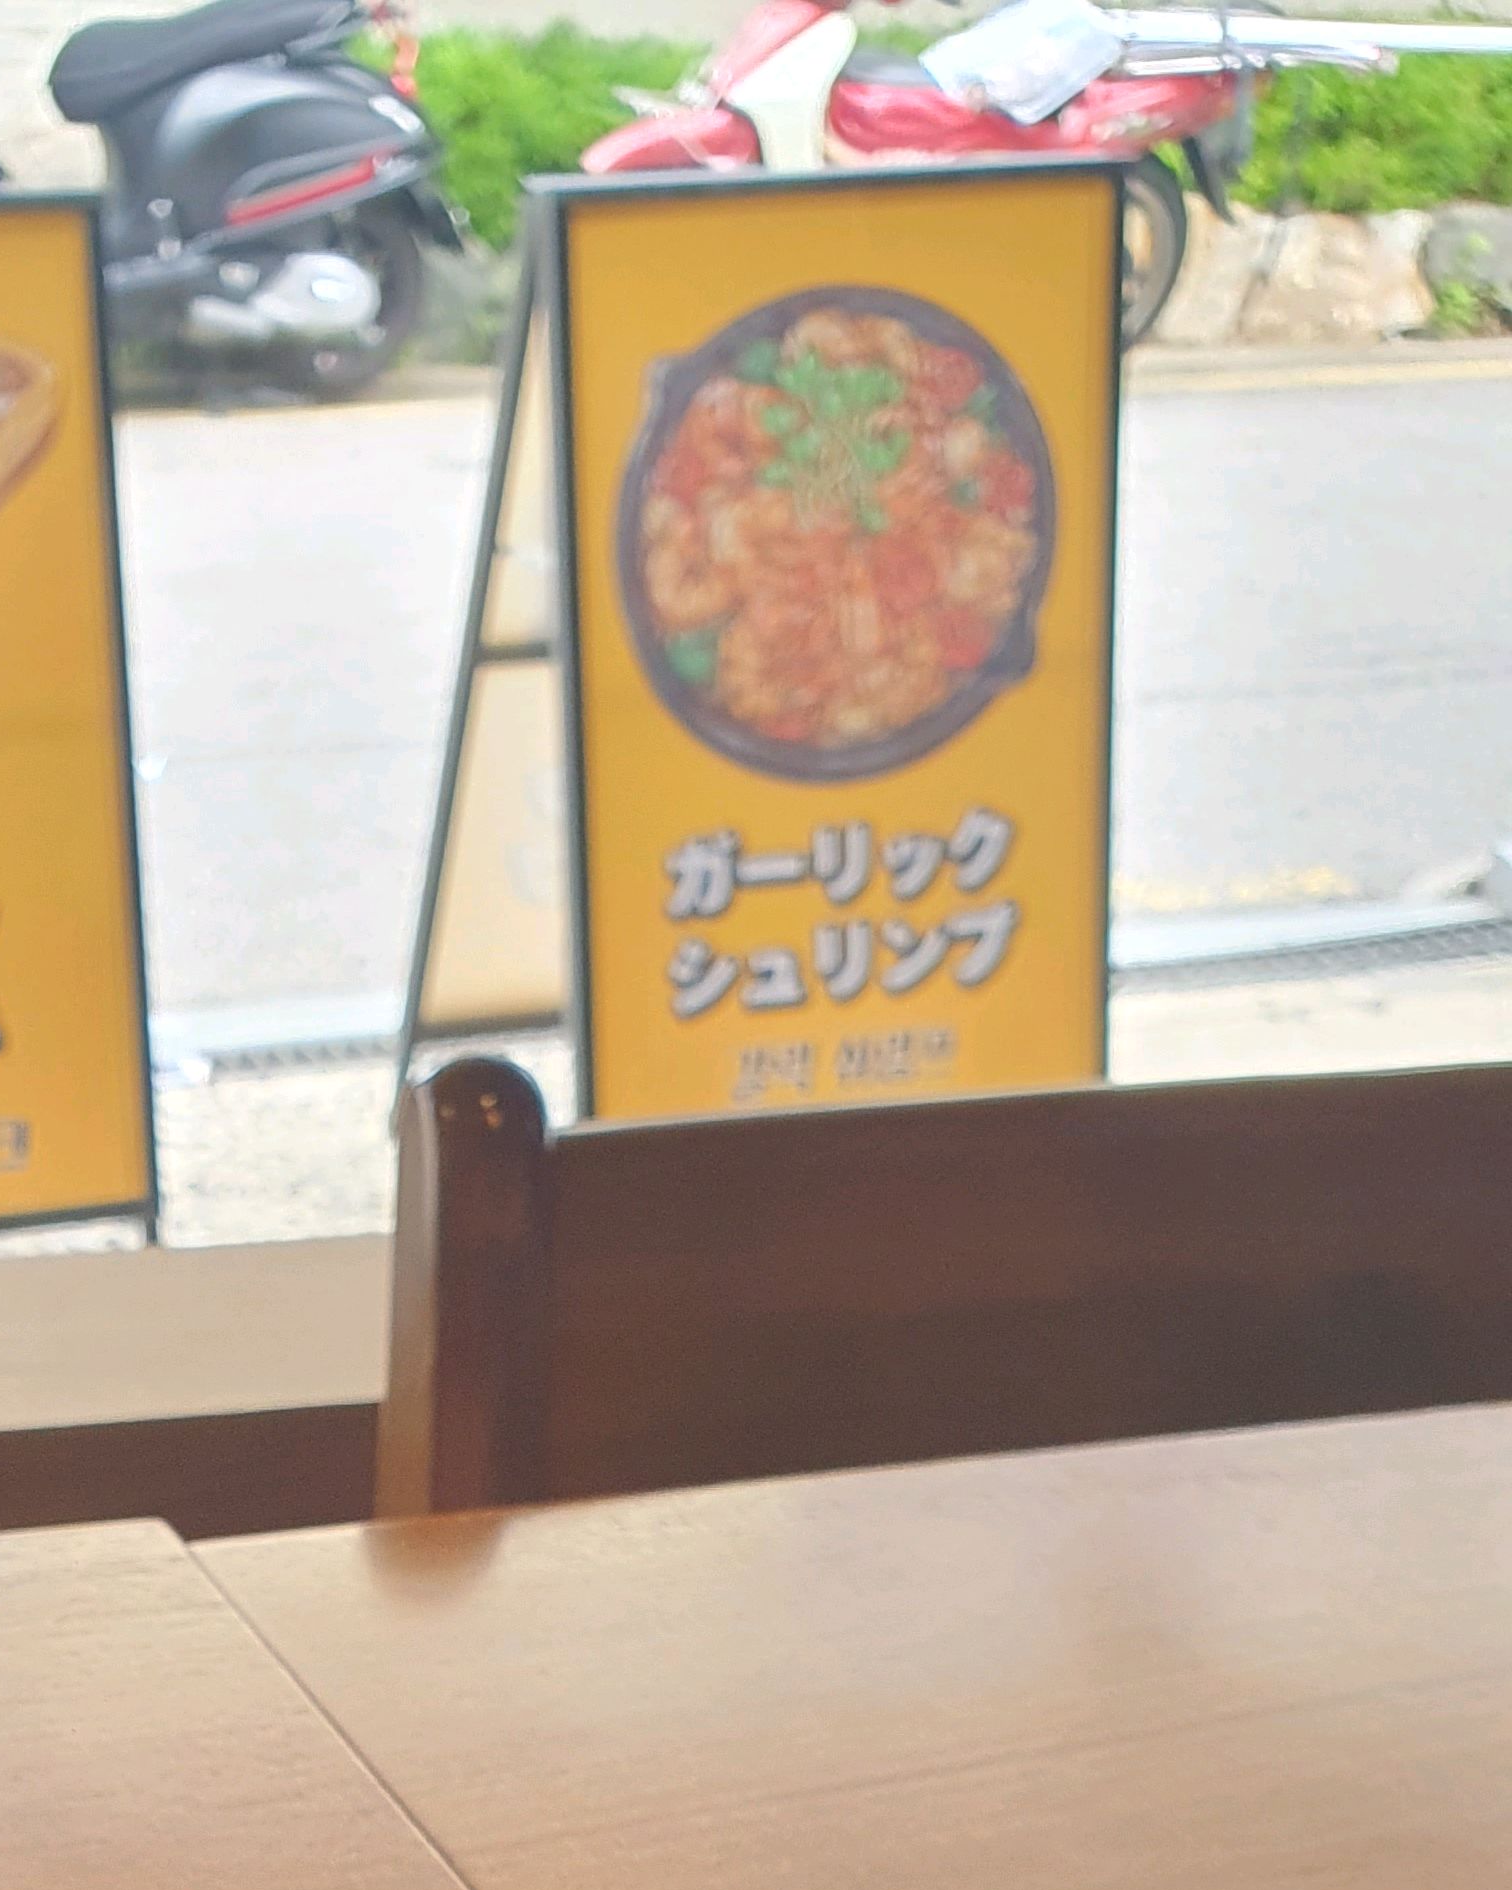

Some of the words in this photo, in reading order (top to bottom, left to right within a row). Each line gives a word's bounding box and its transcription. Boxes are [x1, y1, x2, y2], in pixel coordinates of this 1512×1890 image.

[664, 806, 1016, 921] ガーリック
